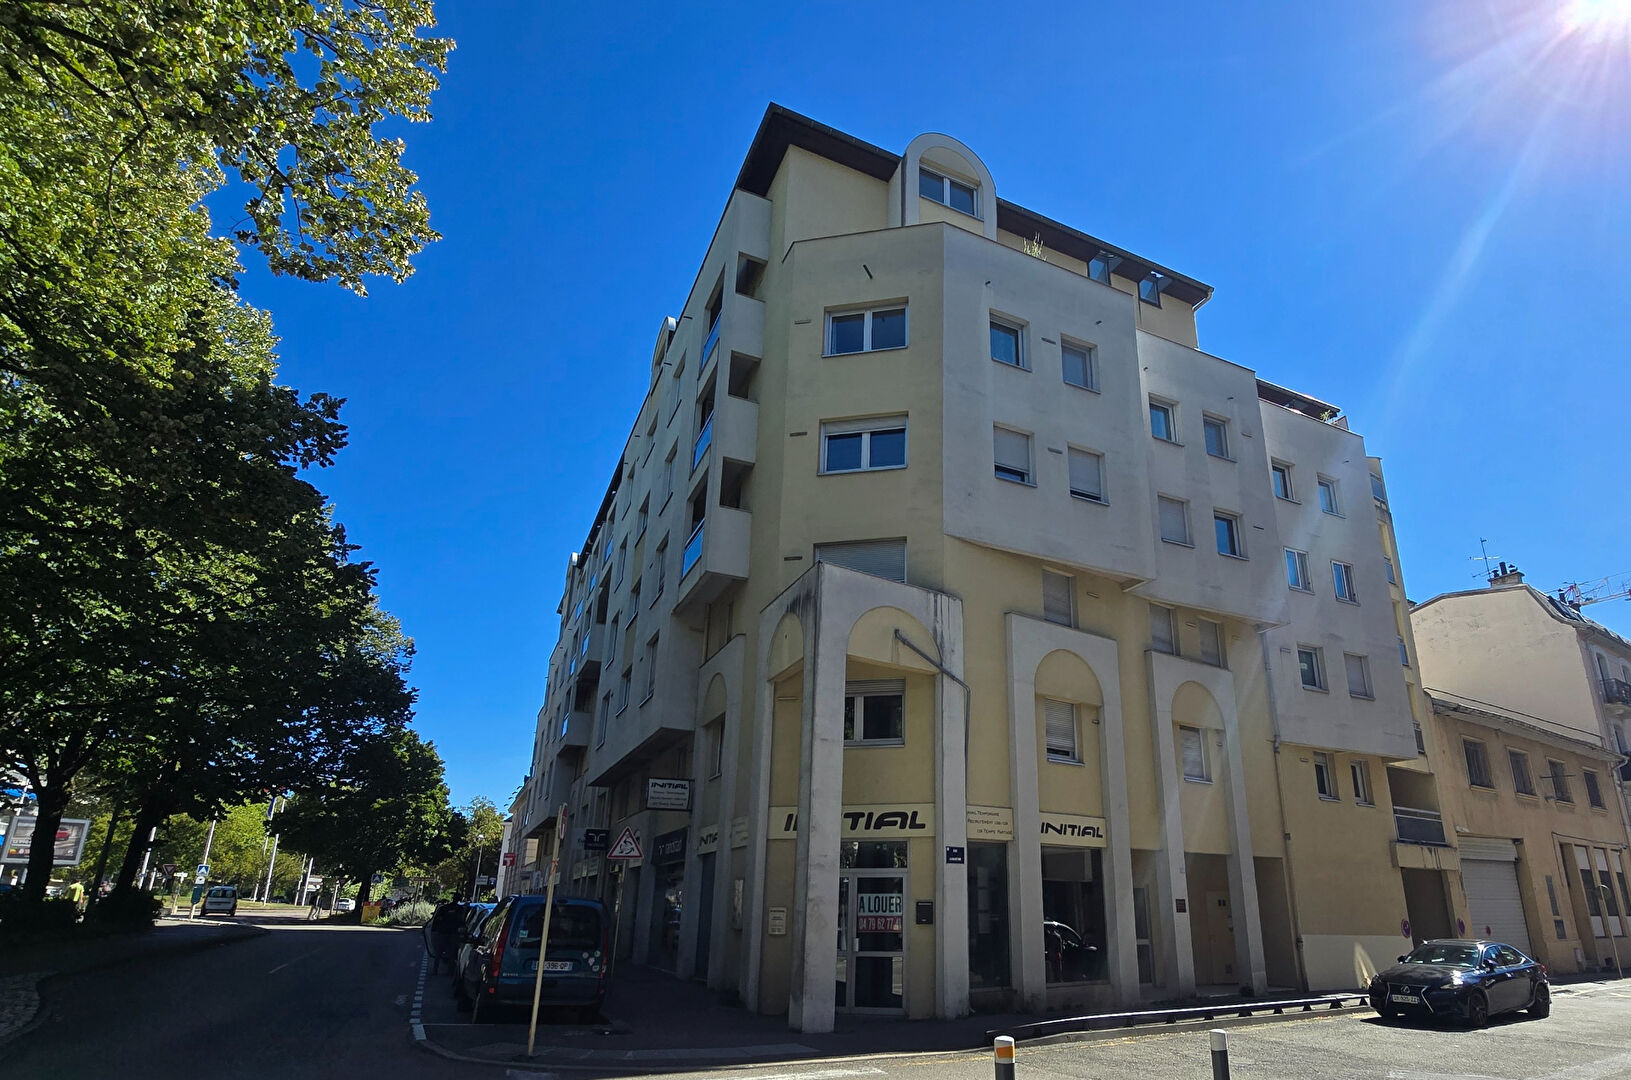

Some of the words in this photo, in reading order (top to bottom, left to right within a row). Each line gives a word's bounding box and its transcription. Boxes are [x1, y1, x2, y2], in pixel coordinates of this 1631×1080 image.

[651, 782, 688, 790] INITIAL
[784, 811, 926, 832] ITIAL
[1040, 822, 1104, 838] INITIAL
[858, 896, 866, 913] A
[868, 896, 902, 913] LOUER
[858, 917, 867, 930] 04
[868, 917, 876, 930] 79
